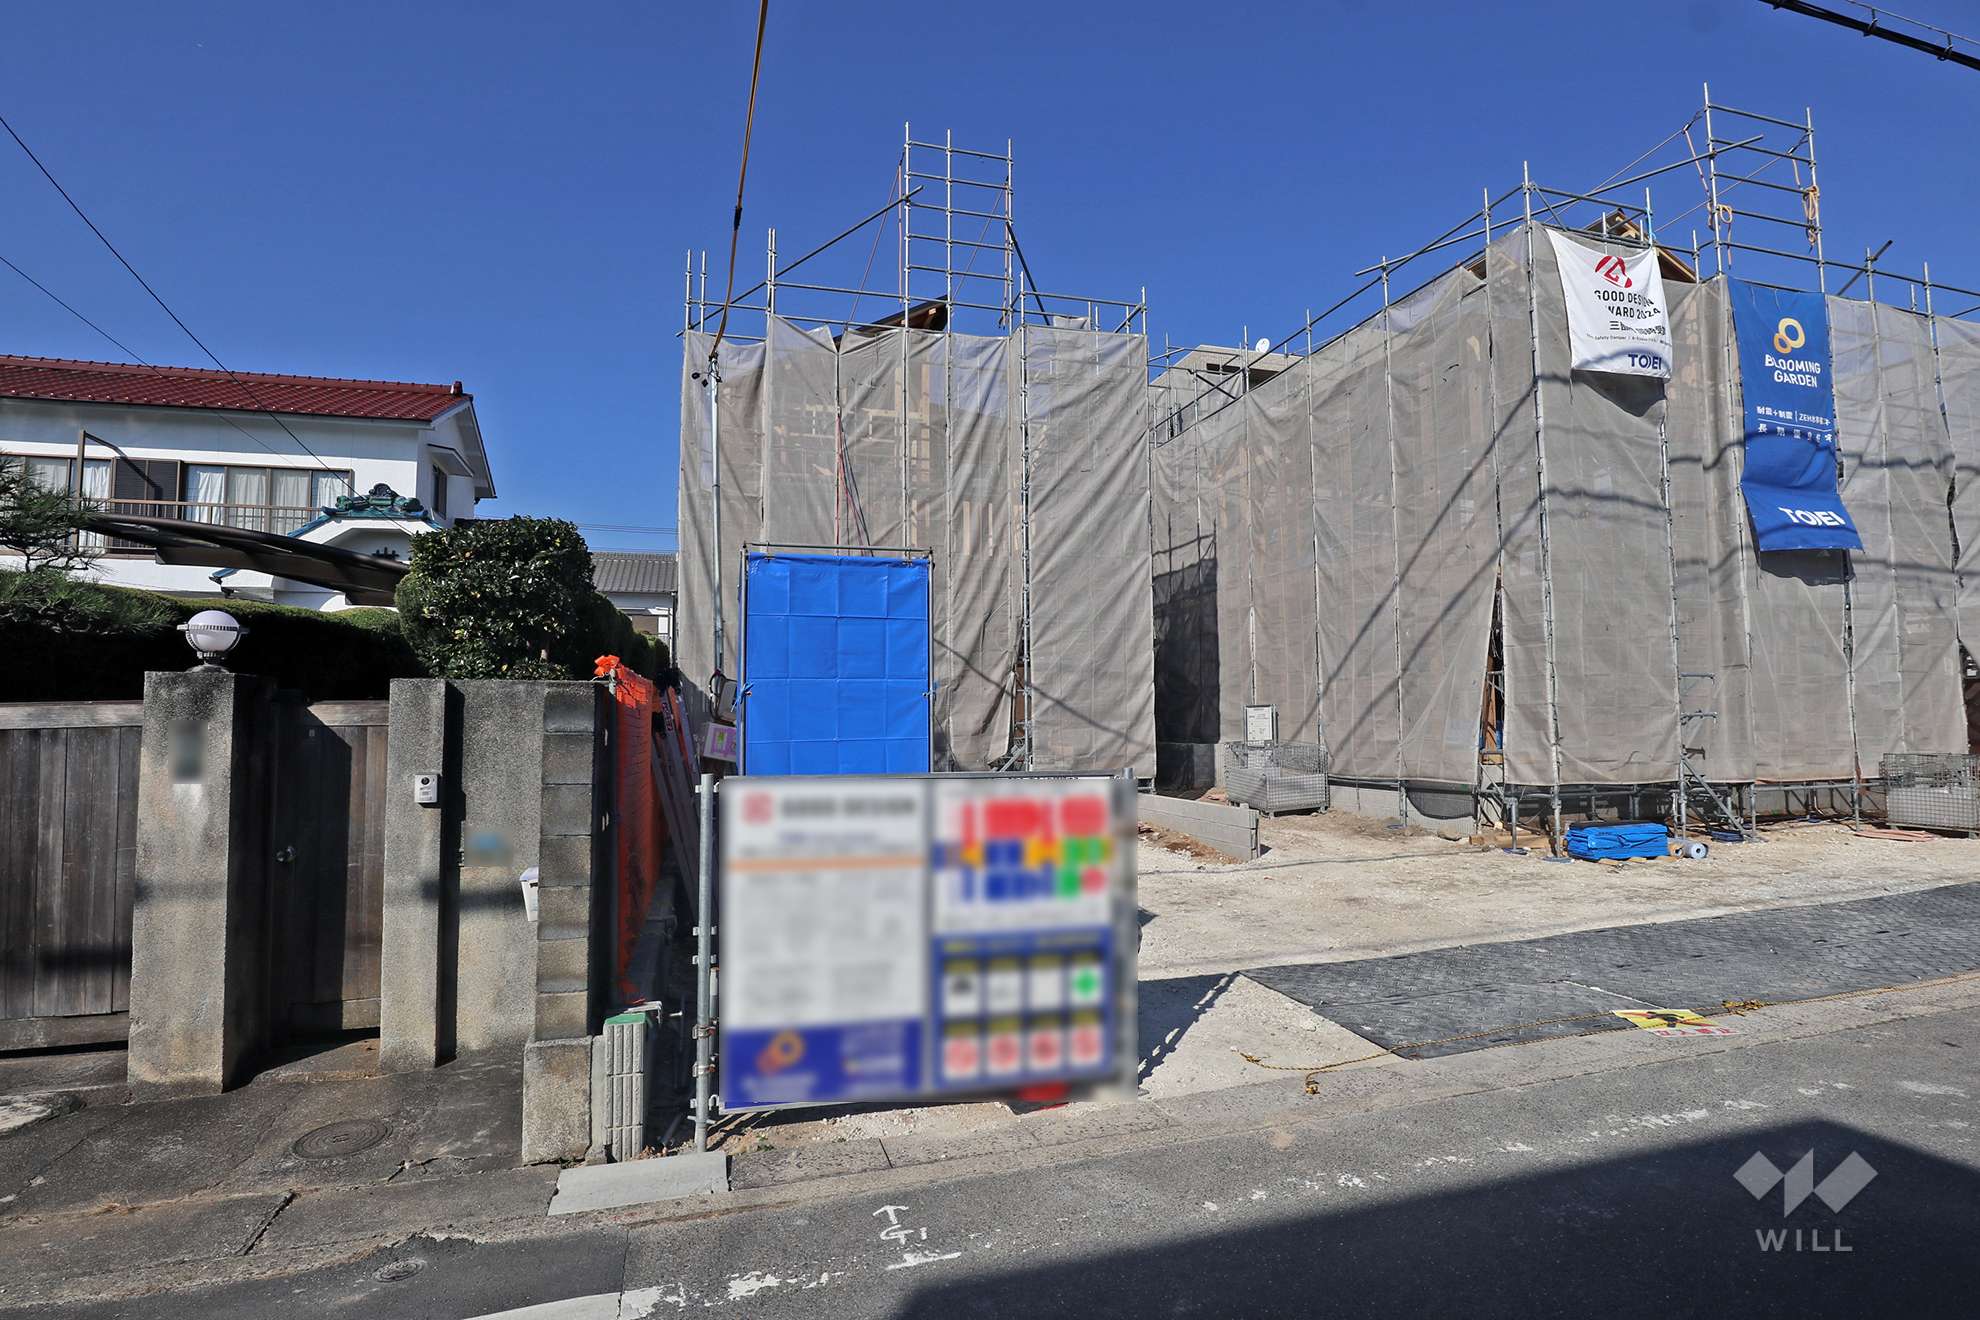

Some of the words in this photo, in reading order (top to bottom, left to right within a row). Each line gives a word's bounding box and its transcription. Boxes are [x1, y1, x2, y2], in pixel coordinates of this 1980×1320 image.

[1636, 308, 1661, 319] 2024
[1765, 354, 1821, 374] BLOOMING
[1774, 370, 1818, 388] GARDEN
